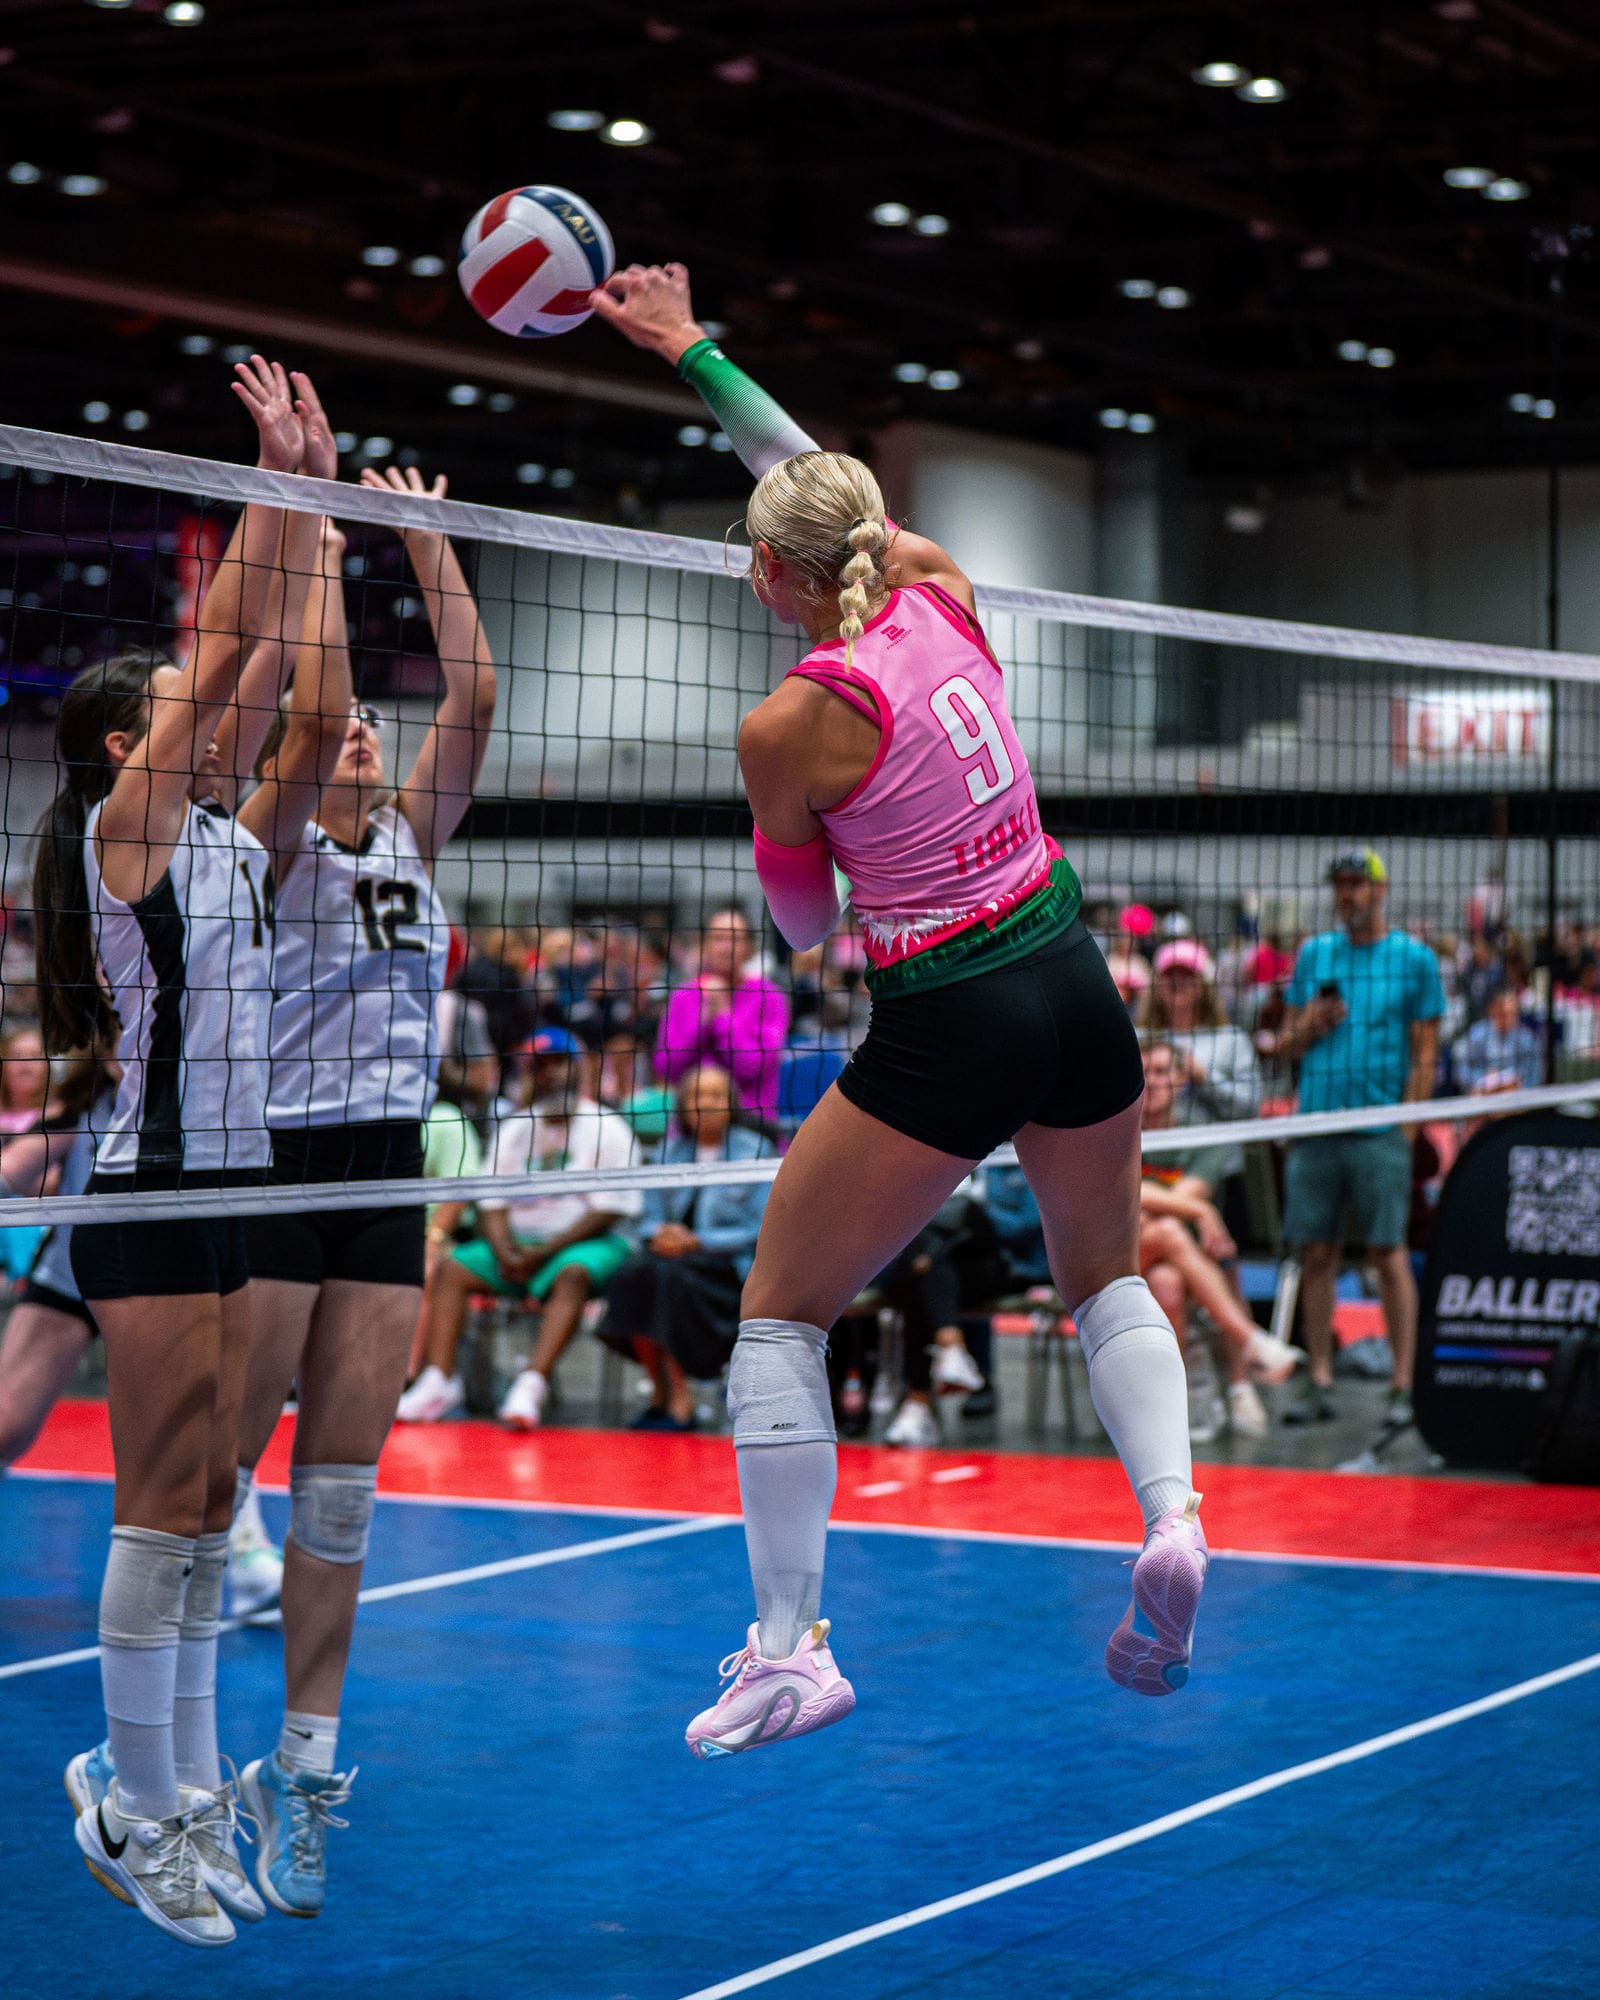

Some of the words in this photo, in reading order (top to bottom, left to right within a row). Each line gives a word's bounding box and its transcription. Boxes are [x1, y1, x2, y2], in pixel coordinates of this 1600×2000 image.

[552, 203, 597, 245] AAU
[928, 674, 1017, 808] 9
[353, 877, 427, 954] 12
[1435, 1273, 1600, 1325] BALLER
